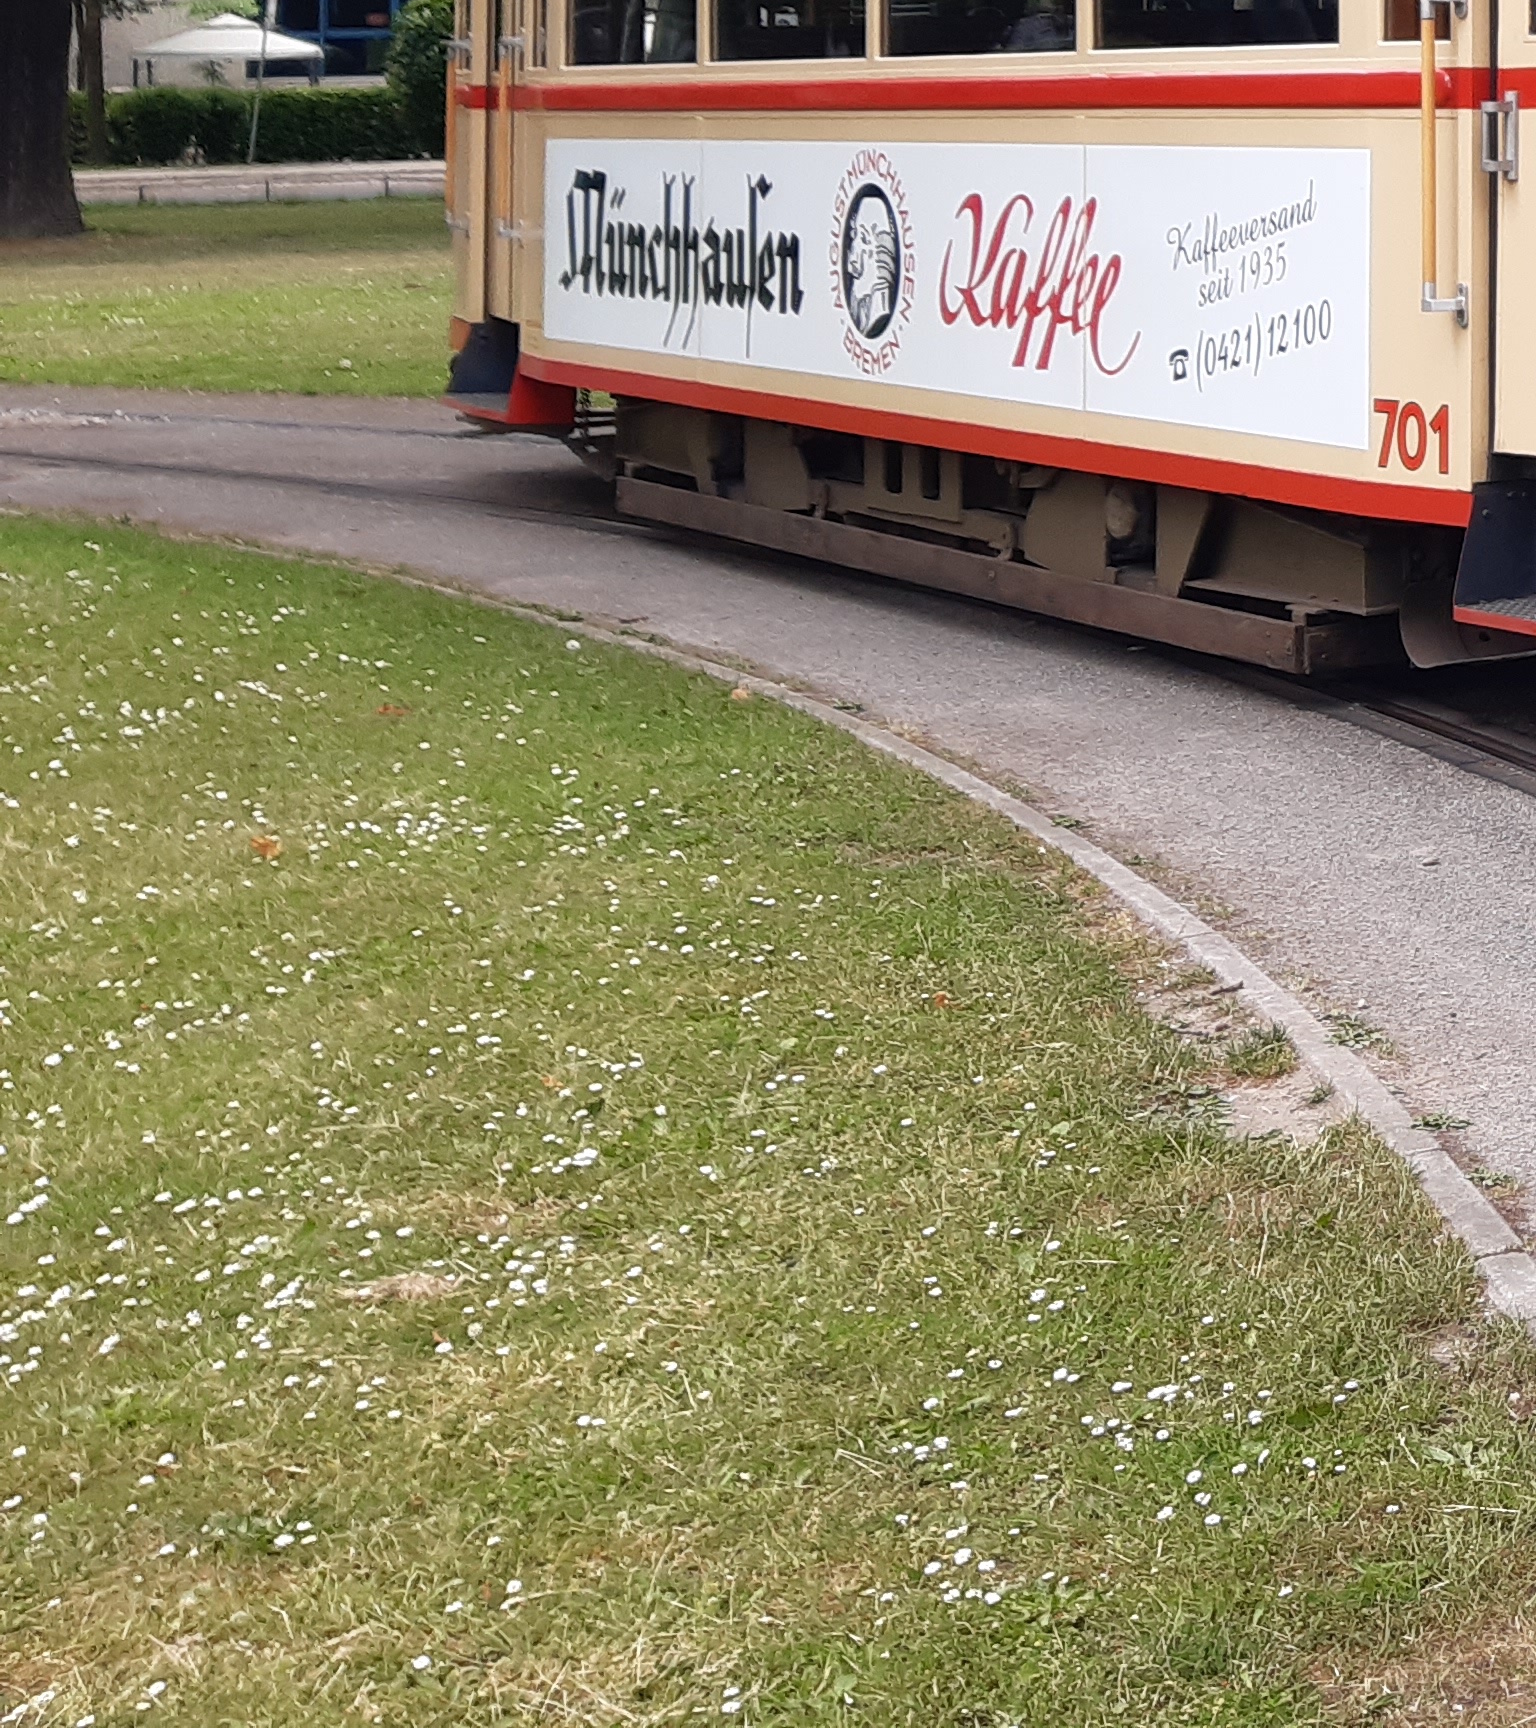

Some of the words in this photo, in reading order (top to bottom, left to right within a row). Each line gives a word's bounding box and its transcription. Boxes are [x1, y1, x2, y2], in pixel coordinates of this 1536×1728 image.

[1166, 178, 1318, 276] Kaffeeversand
[939, 192, 1142, 376] Kaffee
[1197, 266, 1234, 308] seit
[1237, 240, 1288, 294] 1935
[842, 324, 902, 376] BREMEN
[1373, 396, 1450, 475] 701
